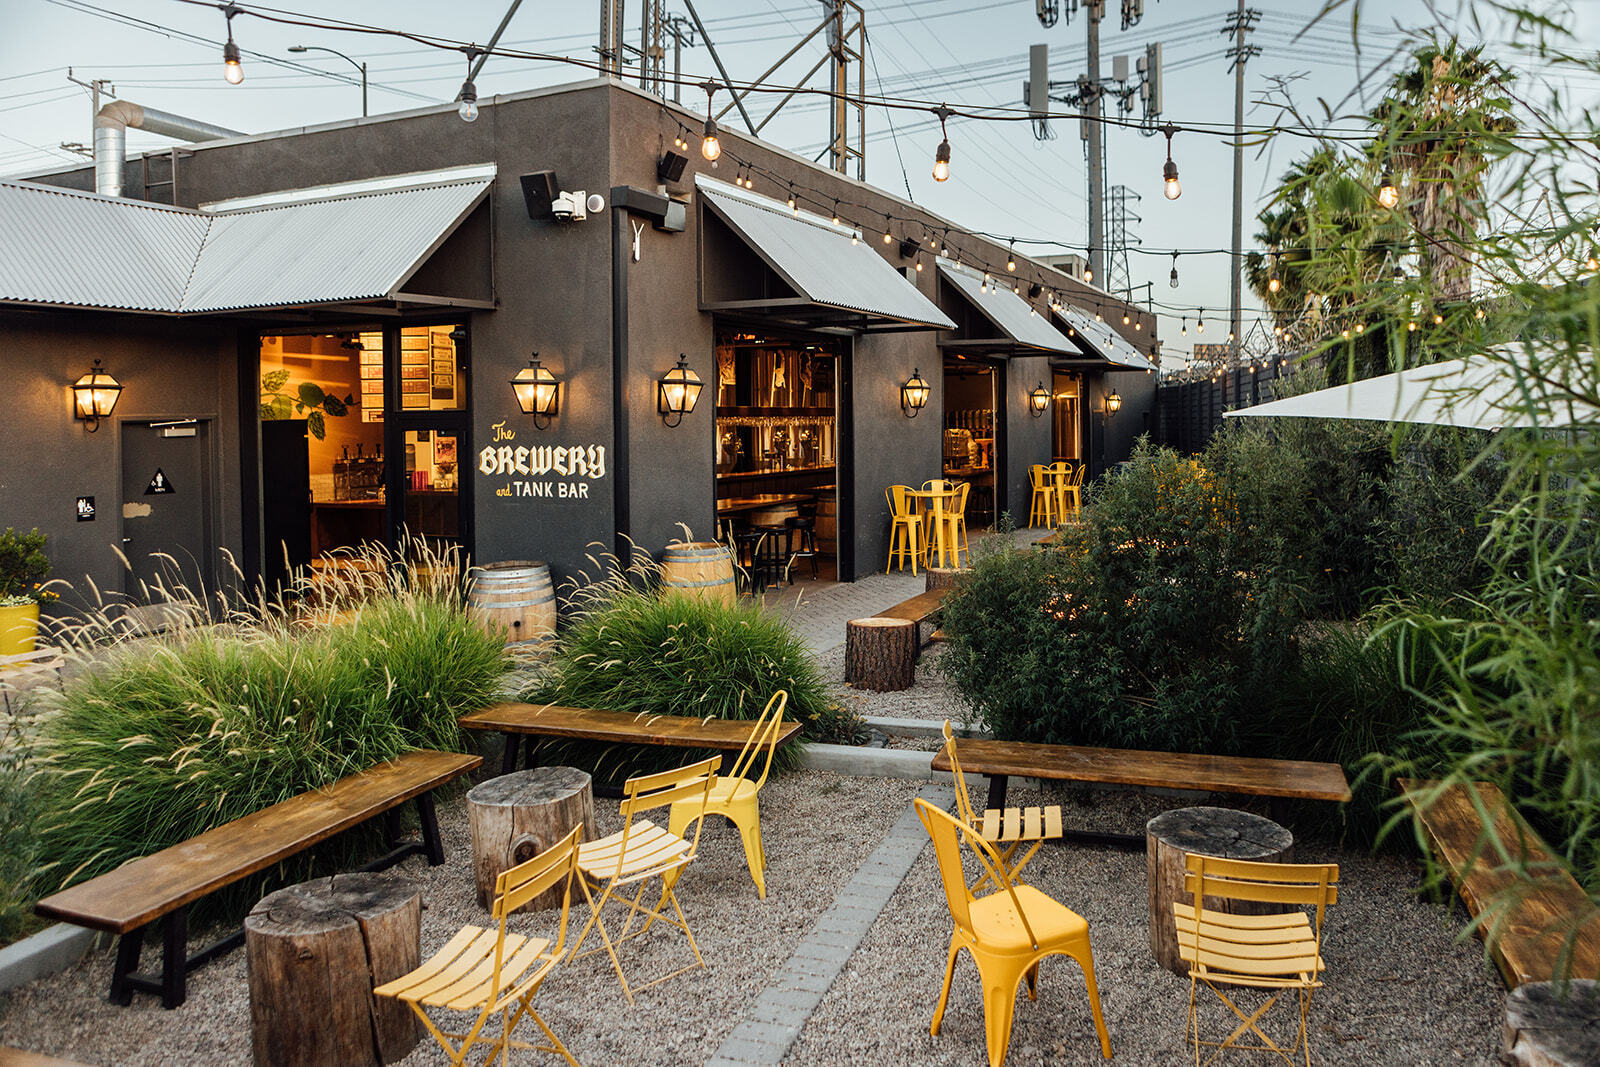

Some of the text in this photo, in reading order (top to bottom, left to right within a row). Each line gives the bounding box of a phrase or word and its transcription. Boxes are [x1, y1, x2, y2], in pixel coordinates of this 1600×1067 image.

[491, 420, 516, 442] The
[479, 444, 605, 479] BREWERY
[496, 482, 589, 498] and TANK BAR
